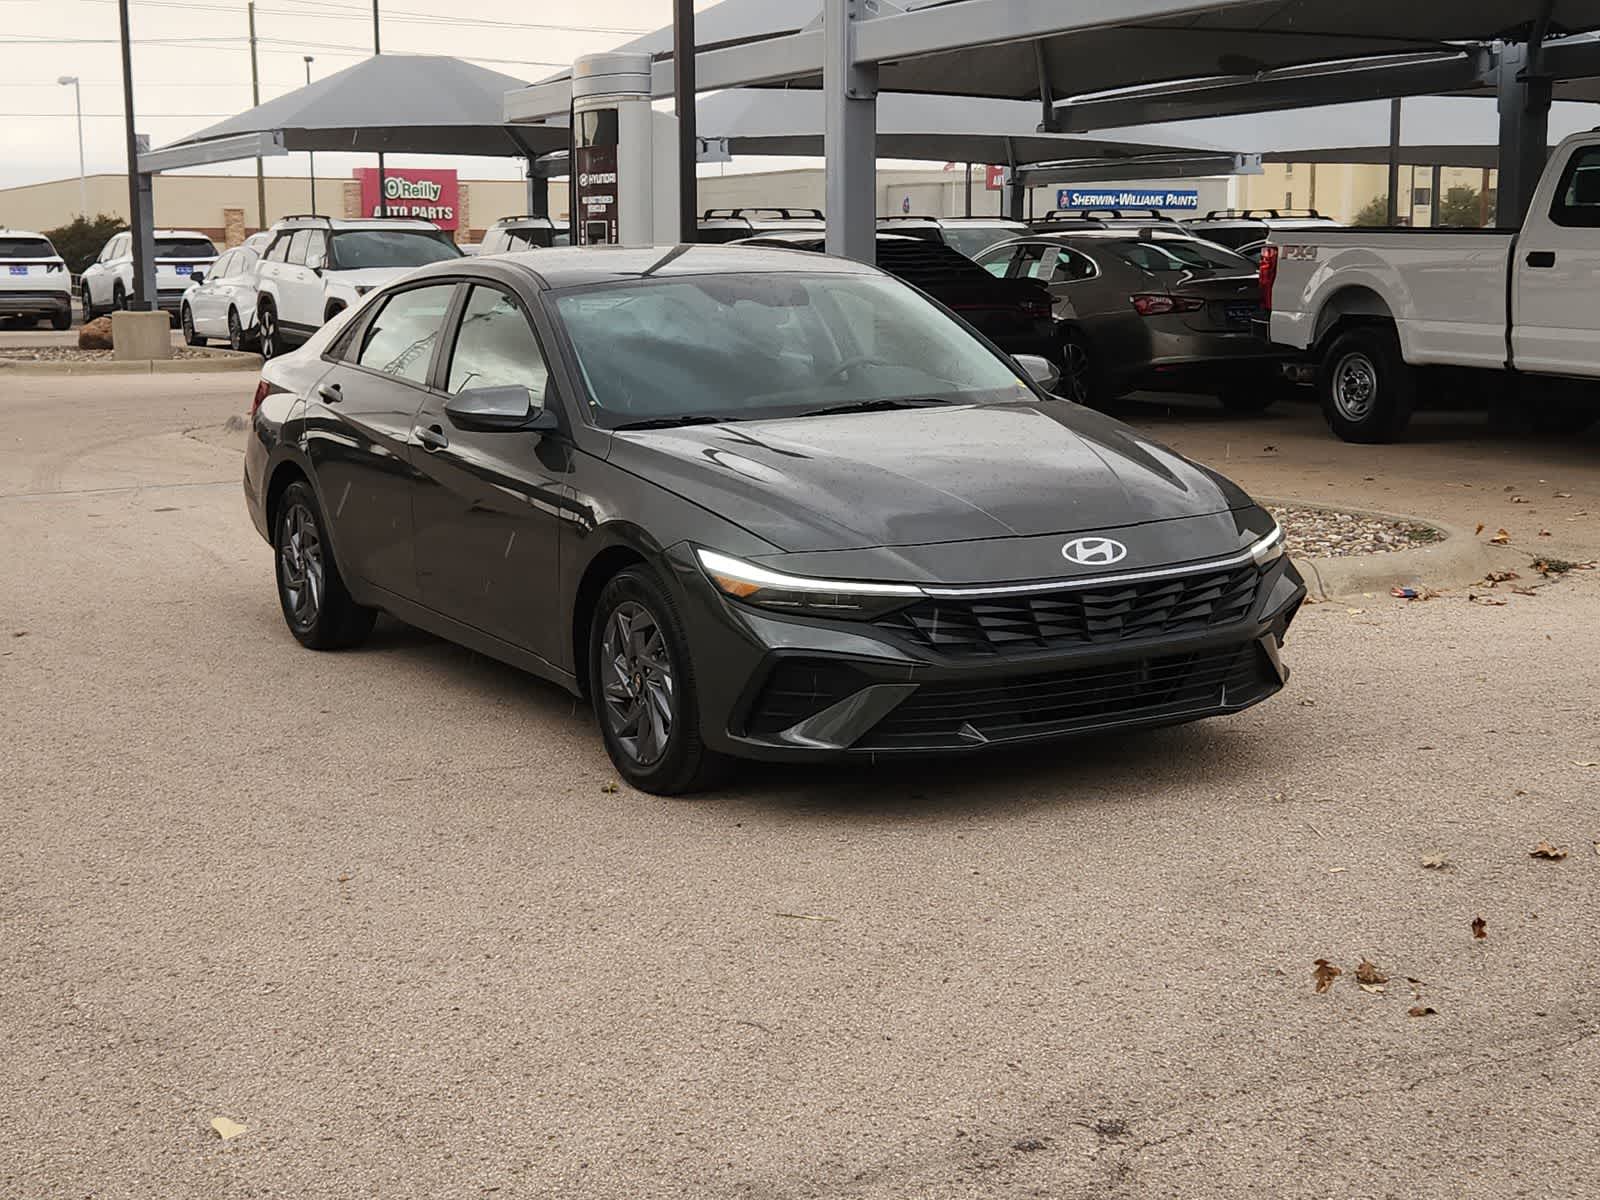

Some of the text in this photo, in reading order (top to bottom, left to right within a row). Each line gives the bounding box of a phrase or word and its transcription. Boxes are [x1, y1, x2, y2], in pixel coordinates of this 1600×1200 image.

[385, 177, 441, 201] O'Reilly
[1071, 191, 1198, 206] SHERWIN-WILLIAMS PAINTS
[411, 205, 454, 220] PARTS
